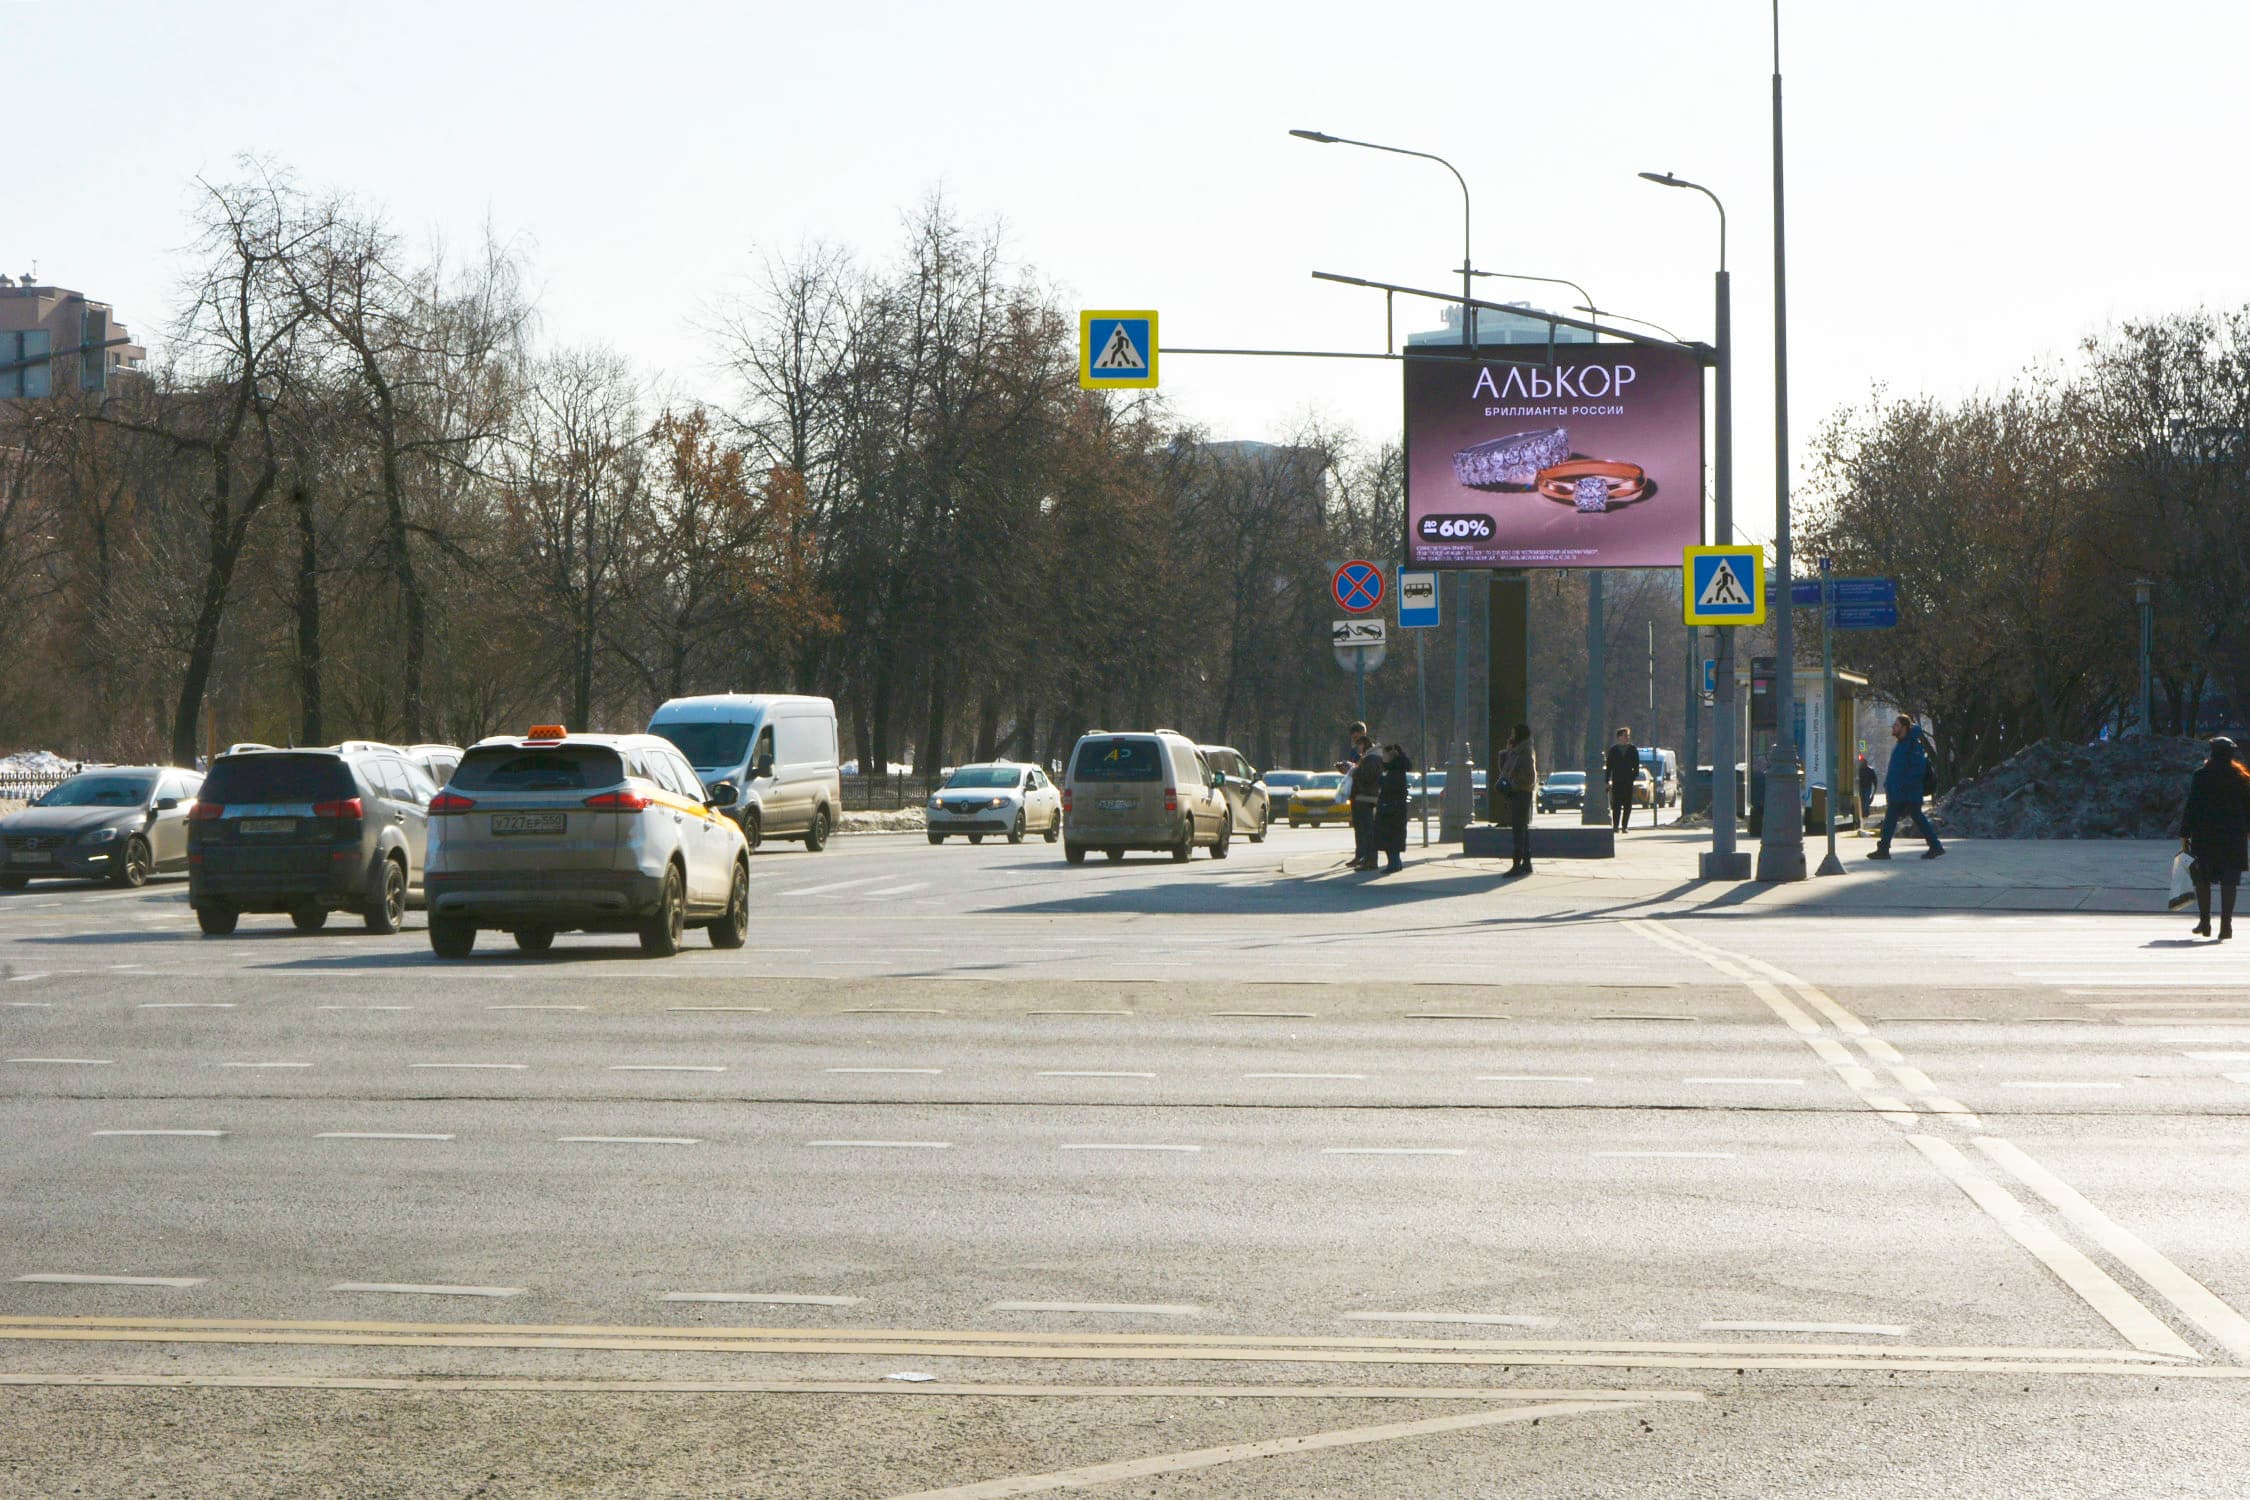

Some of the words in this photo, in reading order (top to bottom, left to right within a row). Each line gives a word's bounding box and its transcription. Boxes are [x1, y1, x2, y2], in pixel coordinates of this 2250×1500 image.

[1472, 365, 1636, 398] АЛЬКОР
[1485, 407, 1568, 416] БРИЛЛИАНТЫ
[1572, 406, 1624, 415] РОССИИ
